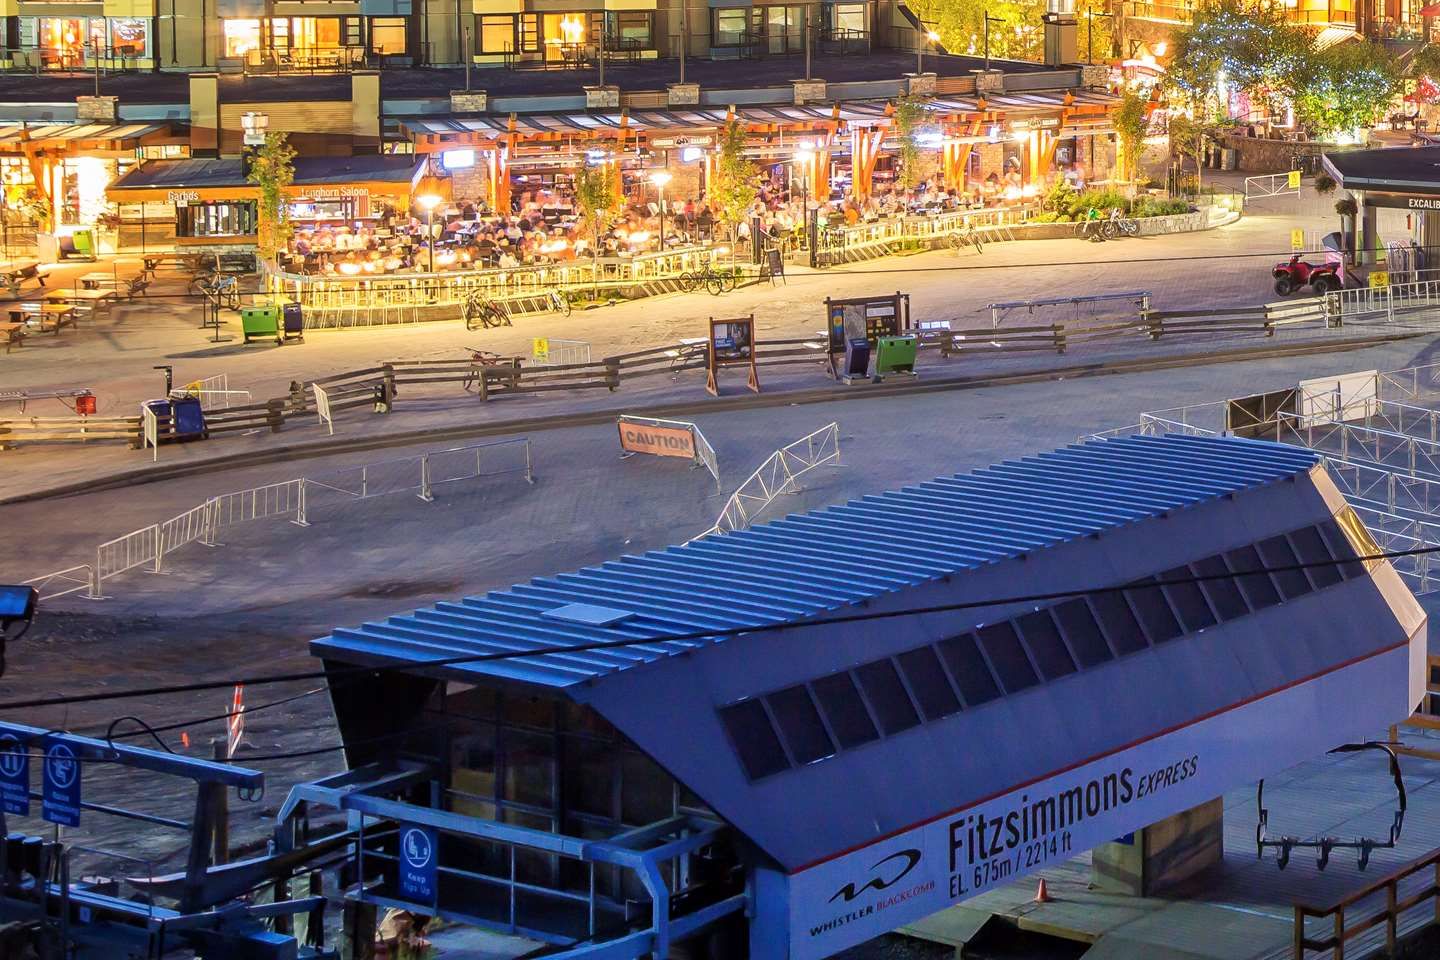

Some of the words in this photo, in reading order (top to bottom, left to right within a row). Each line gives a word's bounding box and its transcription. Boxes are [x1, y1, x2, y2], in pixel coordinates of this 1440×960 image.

[340, 186, 369, 196] Saloon
[626, 431, 690, 450] CAUTION
[949, 767, 1133, 872] Fitzsimmons
[1136, 754, 1199, 800] EXPRESS
[950, 876, 969, 899] EL.
[974, 857, 1011, 889] 675m
[1026, 839, 1057, 868] 2214
[1063, 830, 1072, 853] ft
[810, 905, 874, 937] WHISTLER
[876, 880, 936, 912] BLACKCOMB
